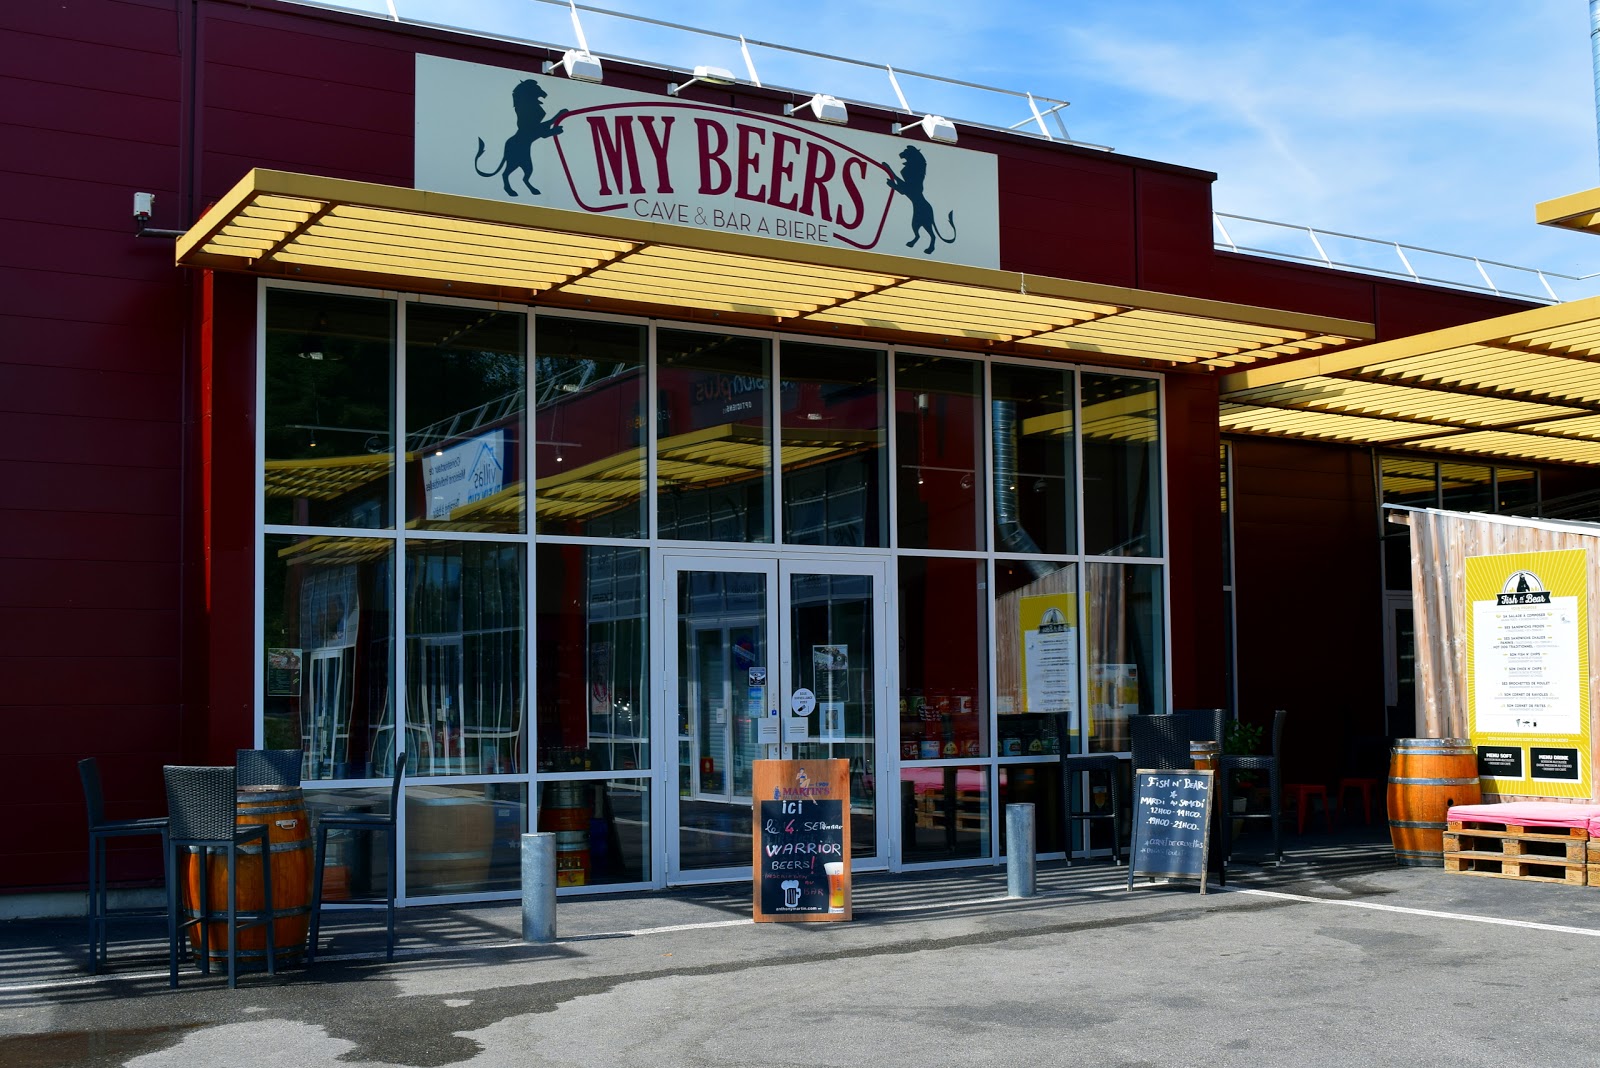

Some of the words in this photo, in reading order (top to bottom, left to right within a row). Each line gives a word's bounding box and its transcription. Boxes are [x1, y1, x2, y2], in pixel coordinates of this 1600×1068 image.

[586, 115, 676, 197] MY
[695, 117, 867, 230] BEERS
[634, 198, 689, 224] CAVE
[695, 206, 708, 226] &
[714, 209, 753, 234] BAR
[776, 217, 829, 244] BIERE
[1501, 595, 1518, 605] Fish
[1525, 593, 1546, 604] Bear
[782, 786, 830, 798] MARTIN'S
